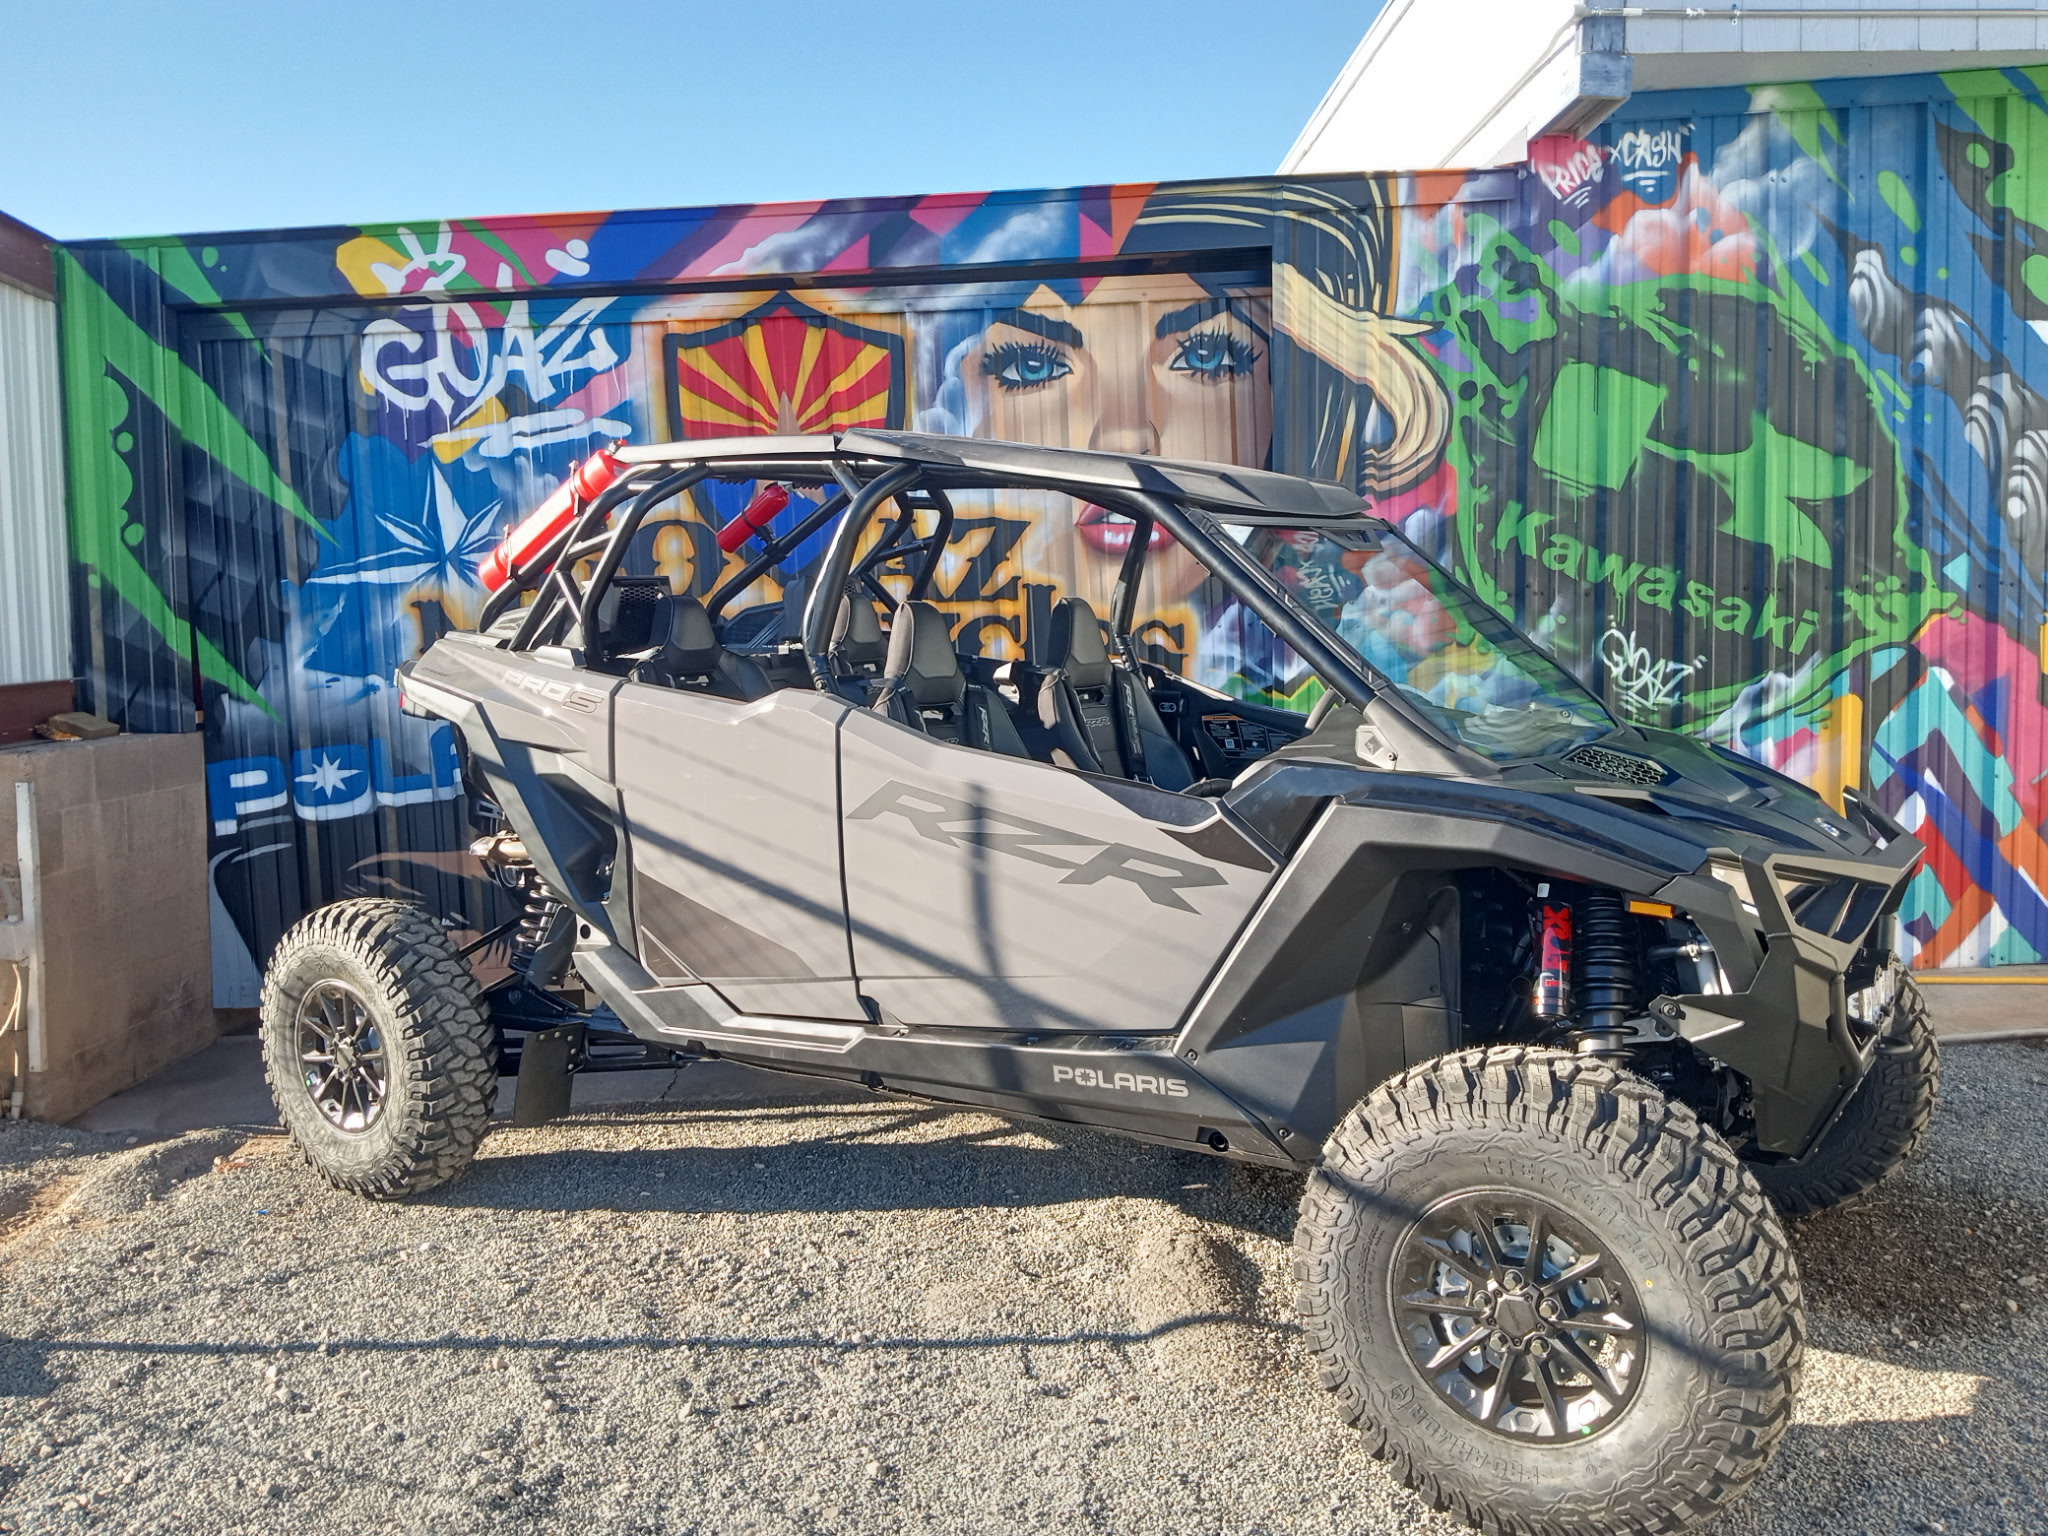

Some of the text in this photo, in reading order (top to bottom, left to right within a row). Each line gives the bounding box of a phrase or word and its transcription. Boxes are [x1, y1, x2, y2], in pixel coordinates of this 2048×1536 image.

[1491, 500, 1819, 655] Kawasaki
[845, 779, 1229, 915] RZR
[1052, 1064, 1189, 1098] POLARIS
